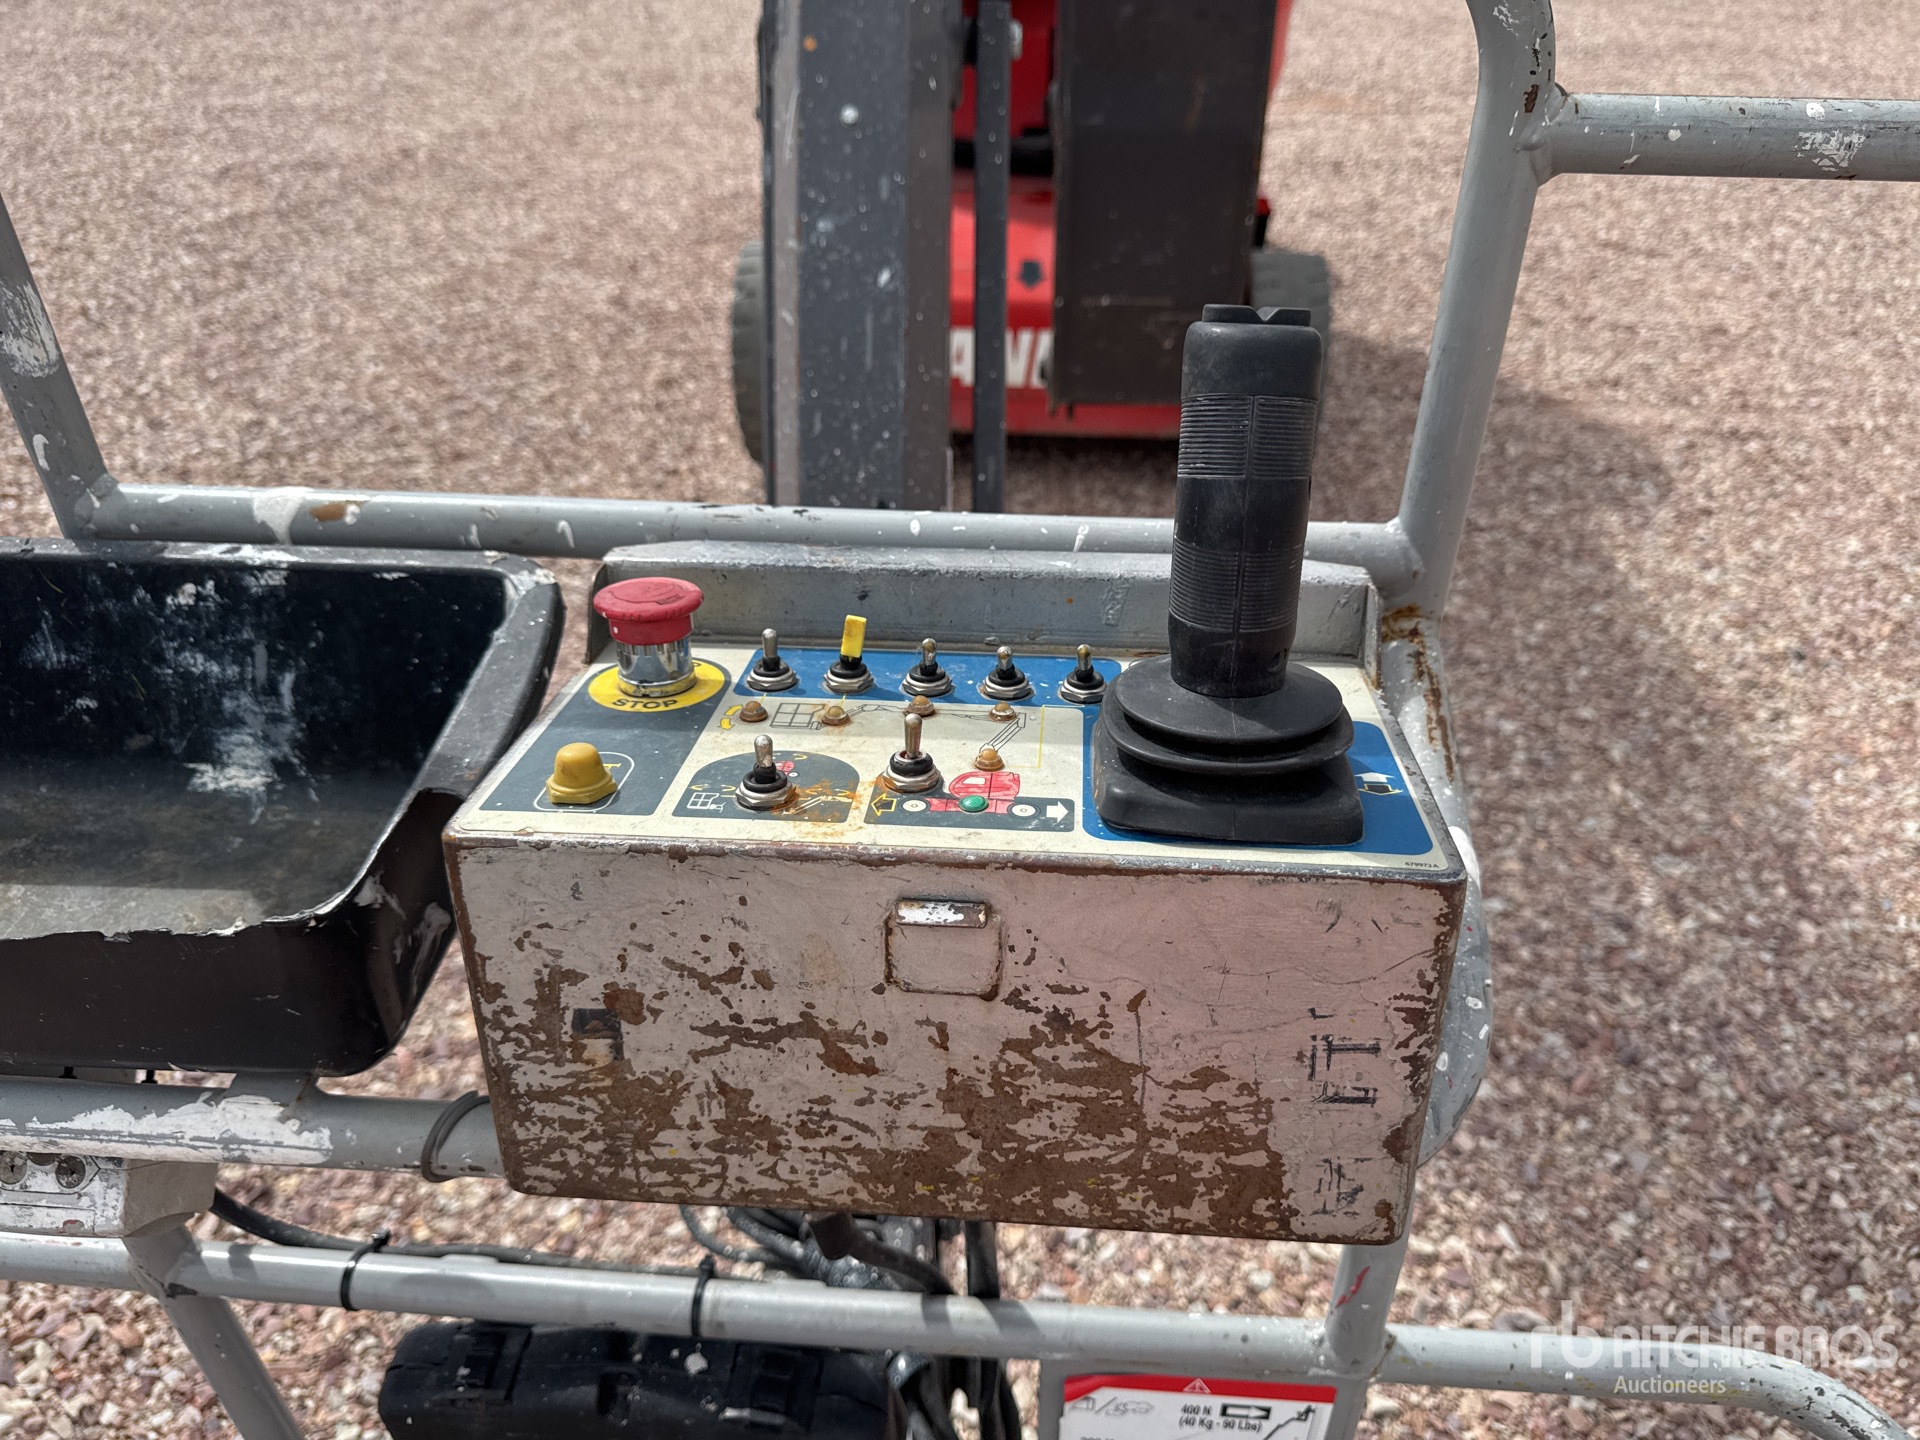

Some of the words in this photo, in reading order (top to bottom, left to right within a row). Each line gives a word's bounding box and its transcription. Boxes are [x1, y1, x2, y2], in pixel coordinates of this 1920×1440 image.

[612, 698, 679, 709] STOP
[1181, 1403, 1200, 1415] 400
[1198, 1417, 1213, 1431] Kg
